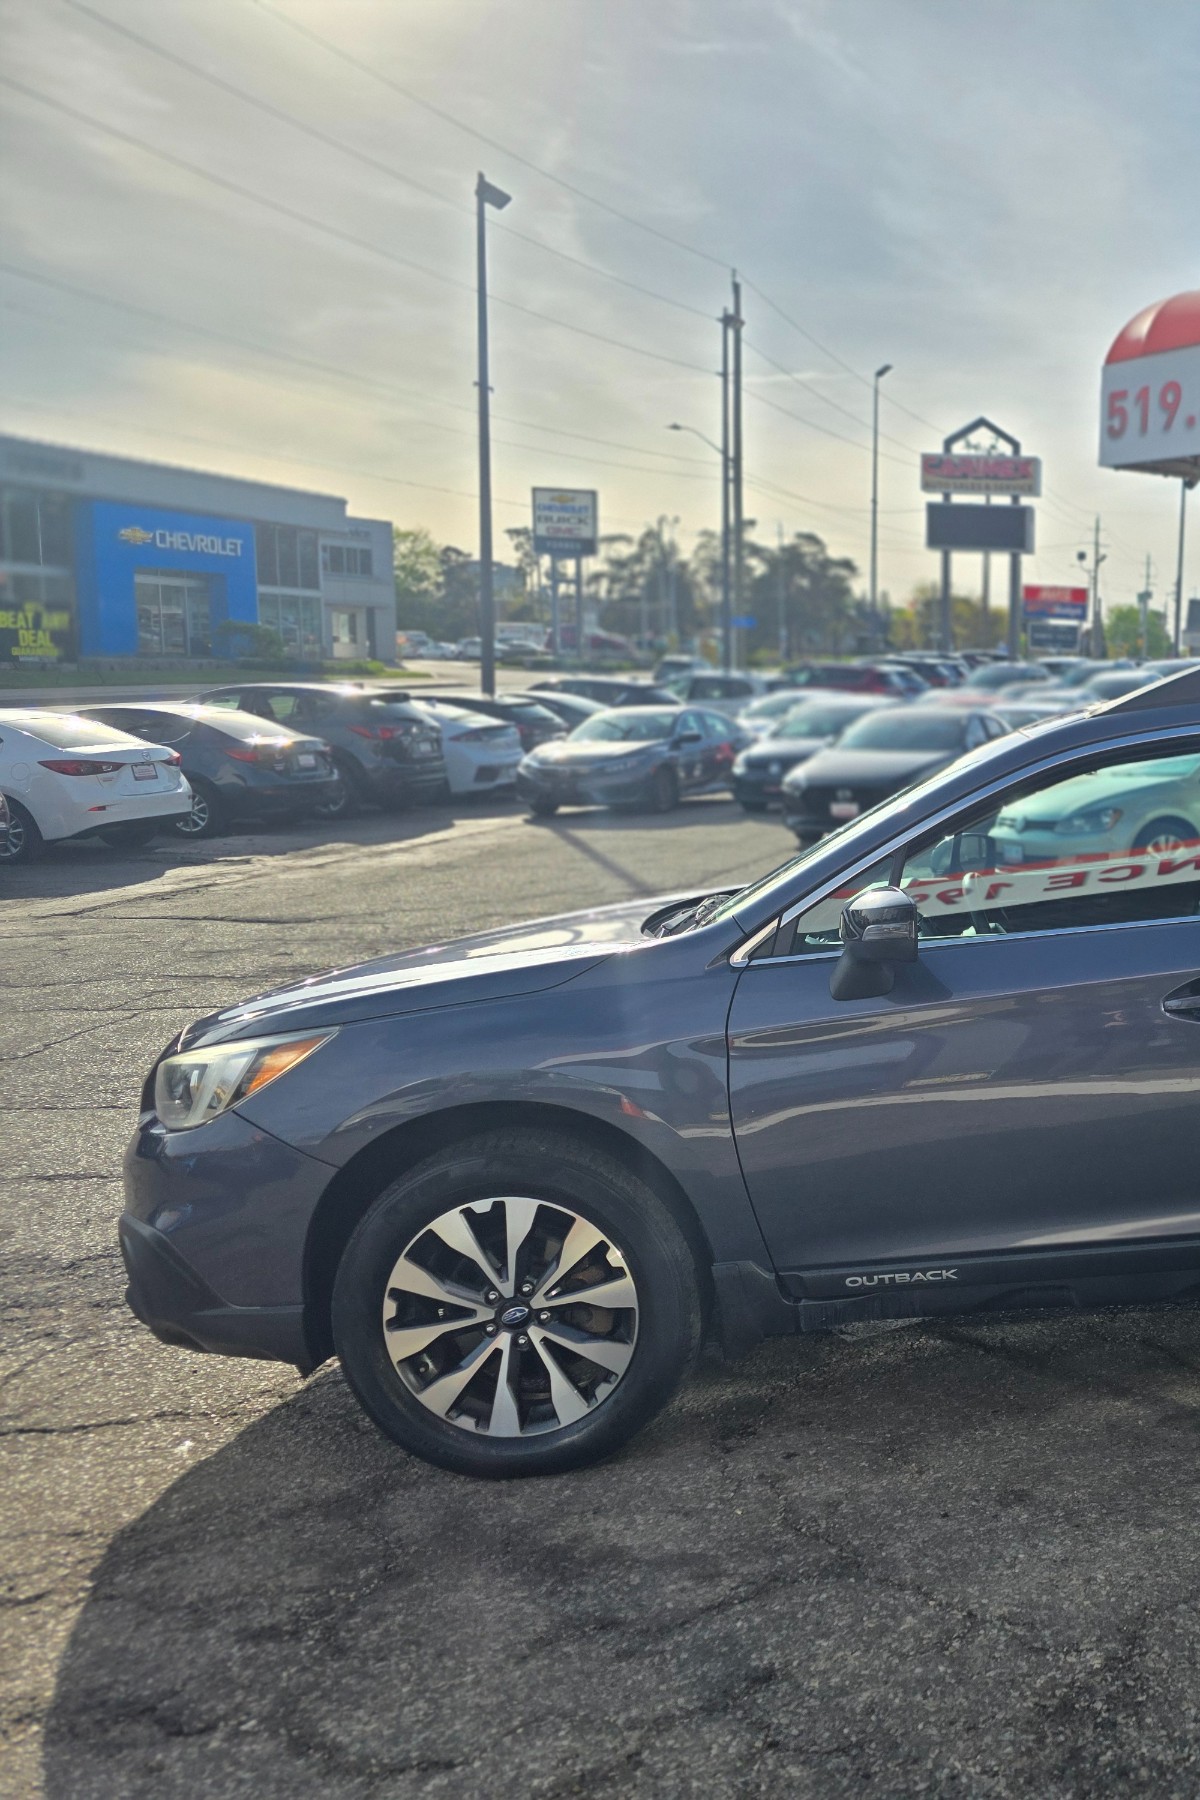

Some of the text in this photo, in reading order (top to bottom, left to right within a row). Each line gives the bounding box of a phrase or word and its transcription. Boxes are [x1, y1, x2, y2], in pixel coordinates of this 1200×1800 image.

[156, 530, 243, 556] CHEVROLET
[19, 630, 54, 647] DEAL
[845, 1269, 958, 1287] OUTBACK
